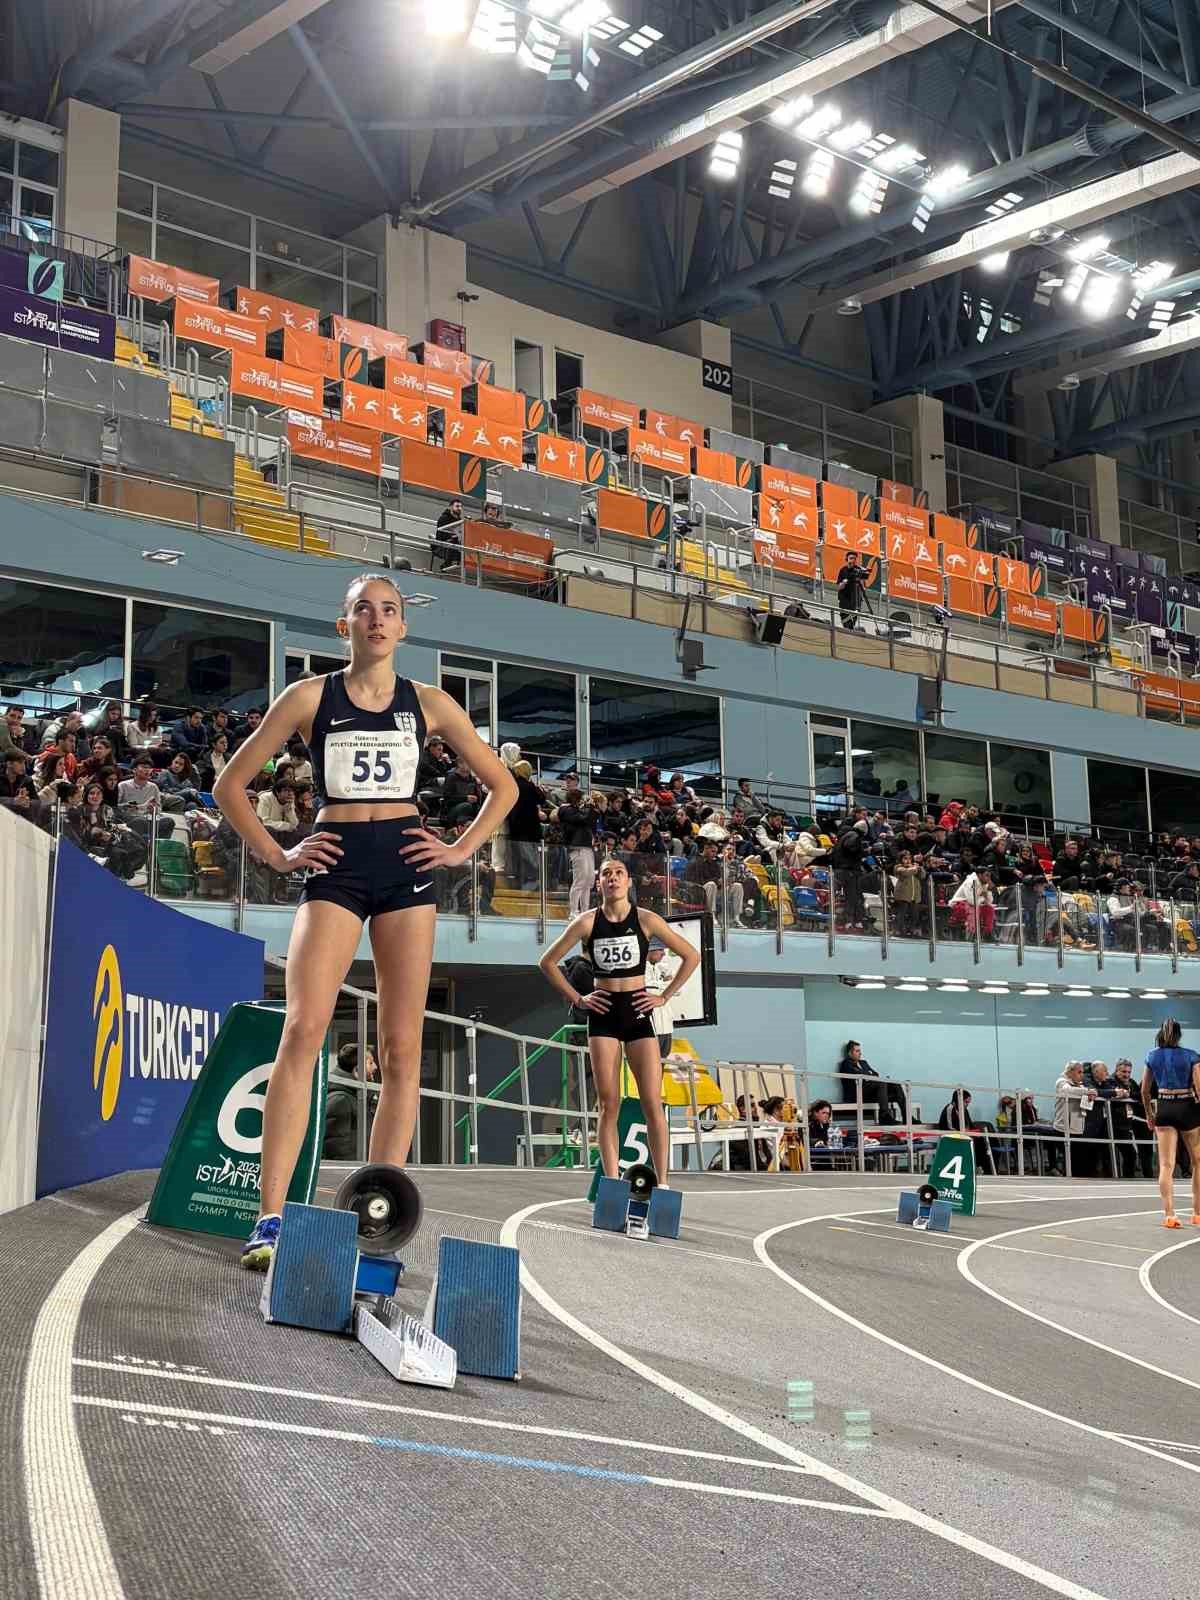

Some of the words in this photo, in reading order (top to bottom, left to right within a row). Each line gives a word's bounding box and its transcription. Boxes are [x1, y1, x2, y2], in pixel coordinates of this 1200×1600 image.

[703, 364, 731, 388] 202
[351, 750, 392, 783] 55
[601, 945, 632, 964] 256
[217, 1062, 274, 1154] 6
[618, 1122, 650, 1169] 5
[236, 1160, 260, 1173] 2023
[939, 1155, 966, 1188] 4
